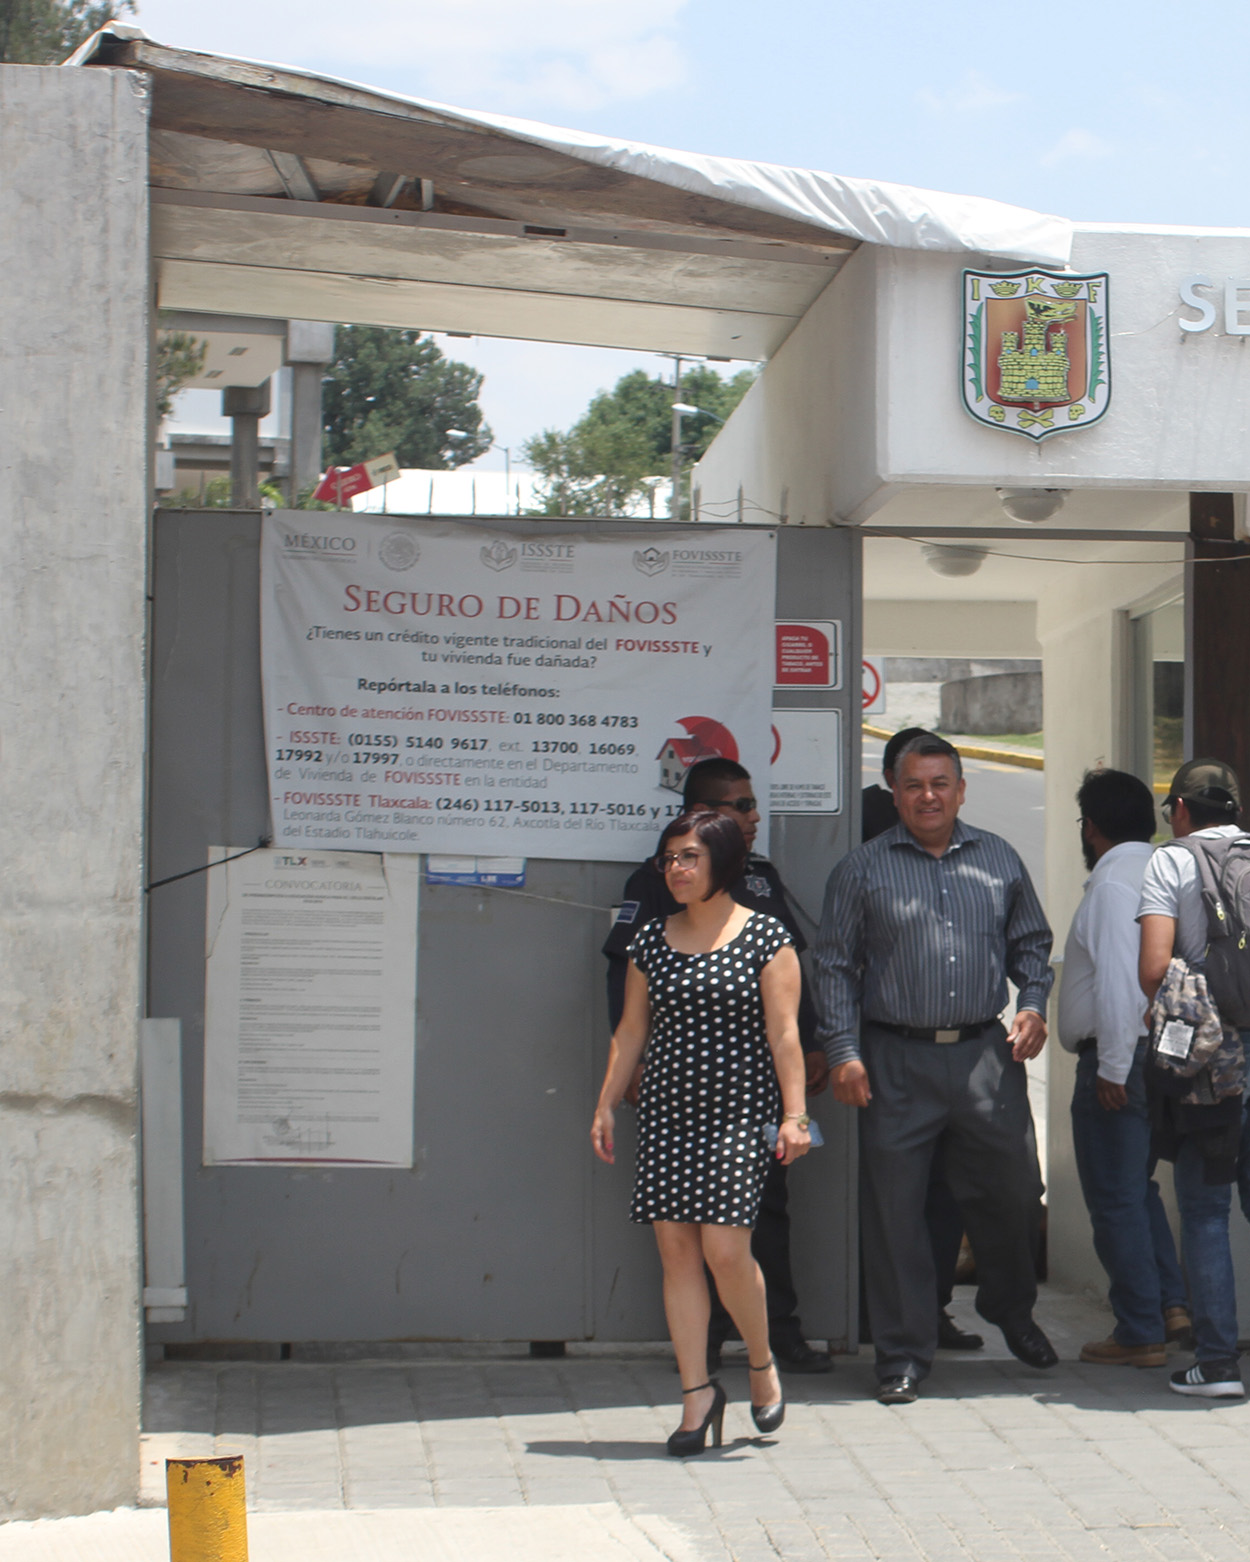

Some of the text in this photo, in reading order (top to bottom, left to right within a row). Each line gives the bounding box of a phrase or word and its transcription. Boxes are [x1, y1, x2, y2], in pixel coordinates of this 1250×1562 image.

[284, 533, 356, 551] MÉXICO
[521, 543, 574, 558] ISSSTE
[672, 550, 742, 562] FOVISSSTE
[306, 625, 713, 657] ¿Tienes un crédito vigente tradicional del FOVISSSTE y
[421, 651, 597, 669] tu vivienda fue dañada?
[357, 677, 560, 698] Repórtala a los teléfonos:
[287, 702, 336, 717] Centro
[340, 704, 358, 718] de
[361, 705, 424, 721] atención
[428, 708, 510, 724] FOVISSSTE:
[513, 712, 532, 725] 01
[537, 713, 565, 726] 800
[569, 714, 597, 727] 368
[601, 715, 638, 728] 4783
[290, 731, 341, 745] ISSSTE:
[348, 734, 398, 748] (0155)
[406, 736, 443, 750] 5140
[276, 749, 322, 762] 17992
[325, 752, 349, 766] y/o
[405, 757, 414, 766] o
[417, 754, 504, 769] directamente
[507, 759, 523, 770] en
[526, 758, 538, 770] el
[543, 758, 638, 774] Departamento
[274, 767, 548, 789] de Vivienda de FOVISSSTE en la entidad
[284, 791, 361, 806] FOVISSSTE
[368, 794, 432, 809] Tlaxcala:
[435, 797, 479, 812] (246)
[484, 800, 565, 815] 117-5013,
[570, 802, 646, 816] 117-5016
[650, 806, 661, 819] y
[283, 809, 340, 822] Leonarda
[344, 810, 389, 824] Gómez
[392, 813, 433, 826] Blanco
[437, 813, 485, 827] número
[563, 818, 582, 830] del
[283, 825, 302, 837] del
[304, 826, 350, 838] Estadio
[265, 880, 362, 891] CONVOCATORIA
